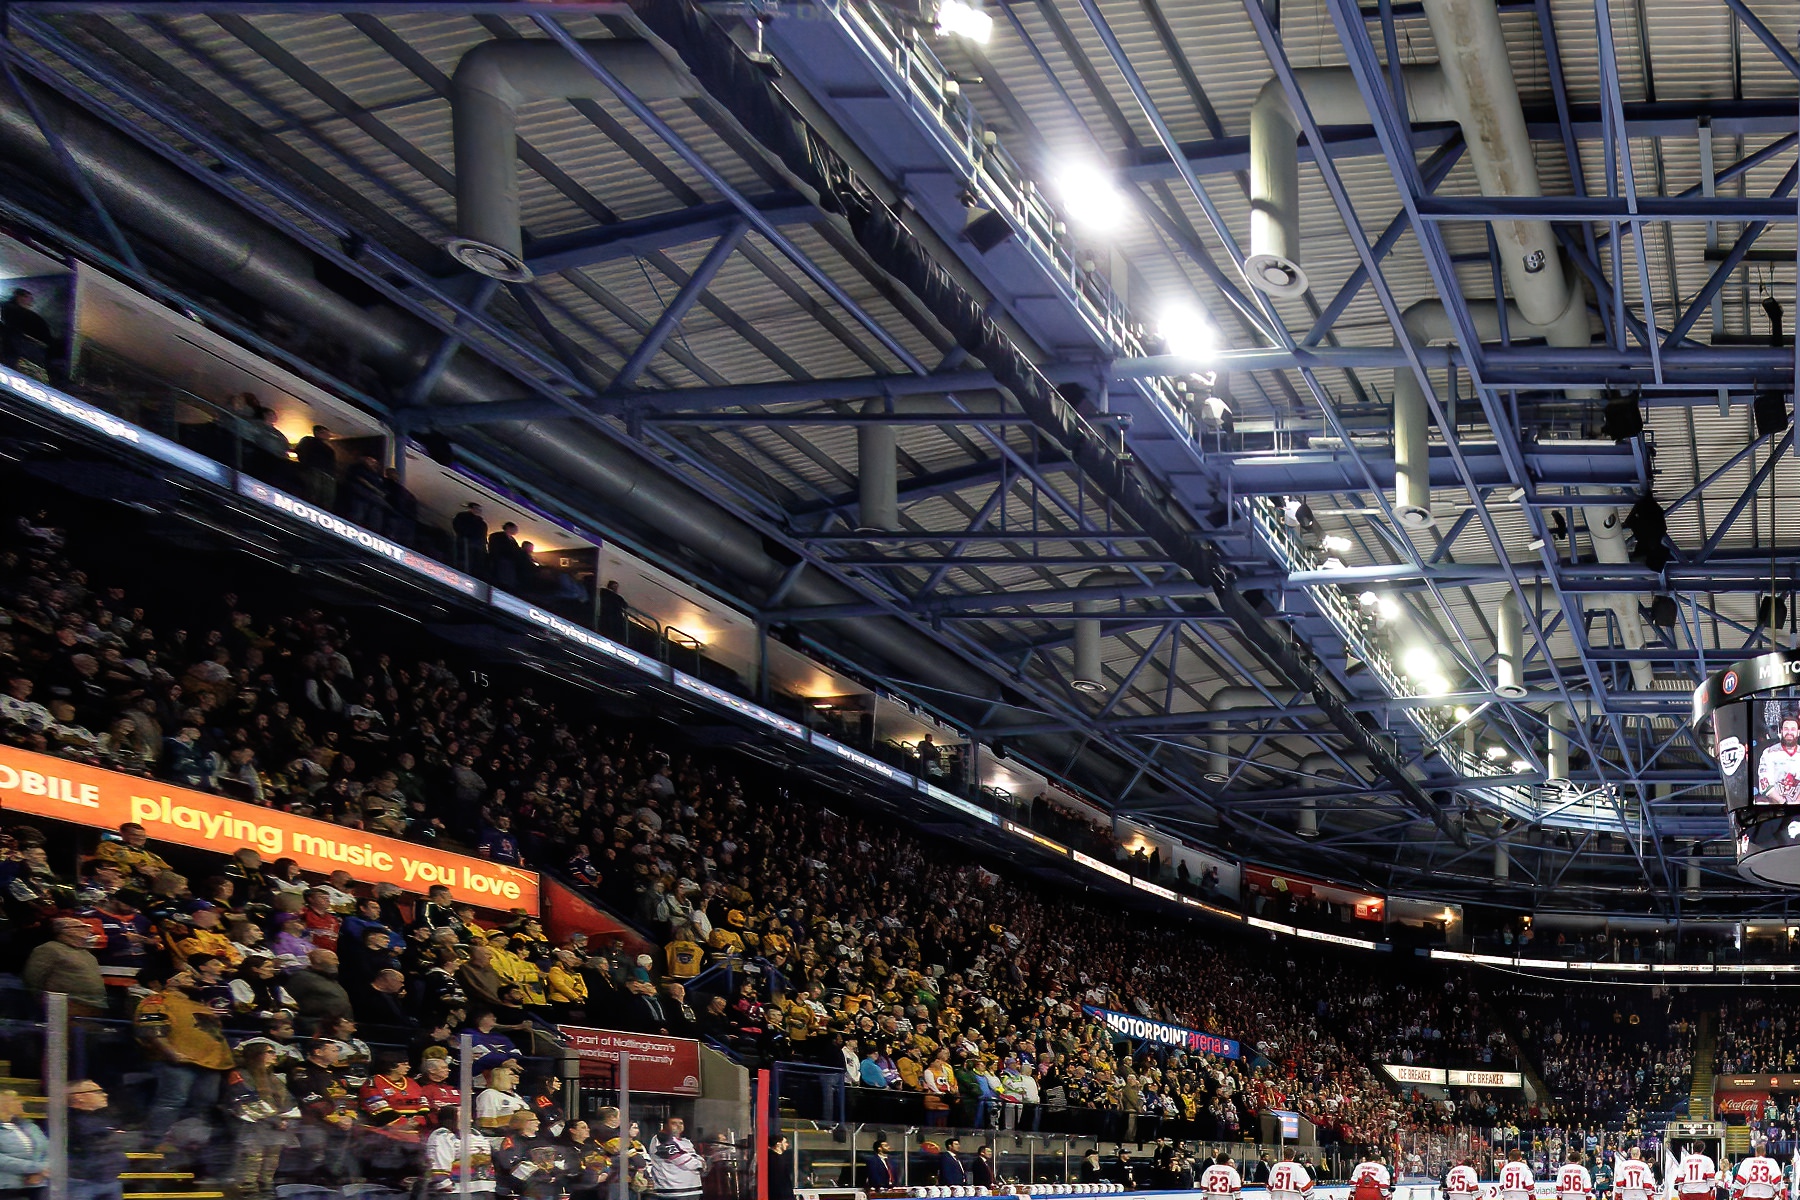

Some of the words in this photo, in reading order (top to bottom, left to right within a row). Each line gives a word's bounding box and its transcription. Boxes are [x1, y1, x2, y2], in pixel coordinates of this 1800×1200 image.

[274, 493, 403, 560] MOTORPOINT
[130, 795, 283, 855] playing
[293, 832, 394, 873] music
[400, 856, 456, 886] you
[463, 867, 521, 900] love
[1107, 1013, 1188, 1046] MOTORPOINT
[1188, 1031, 1221, 1054] arena
[576, 1035, 599, 1046] part
[600, 1036, 611, 1046] of
[613, 1037, 676, 1053] Nottingham's
[578, 1049, 619, 1062] working
[628, 1053, 674, 1066] ommunity
[1398, 1068, 1407, 1079] ICE
[1408, 1069, 1431, 1082] BREAKER
[1466, 1072, 1477, 1084] ICE
[1478, 1073, 1504, 1085] BREAKER
[1275, 1172, 1291, 1189] 31
[1505, 1172, 1519, 1189] 91
[1628, 1171, 1641, 1187] 17
[1689, 1164, 1698, 1180] 11
[1751, 1165, 1769, 1182] 33
[1209, 1176, 1229, 1192] 23
[1563, 1175, 1582, 1192] 96
